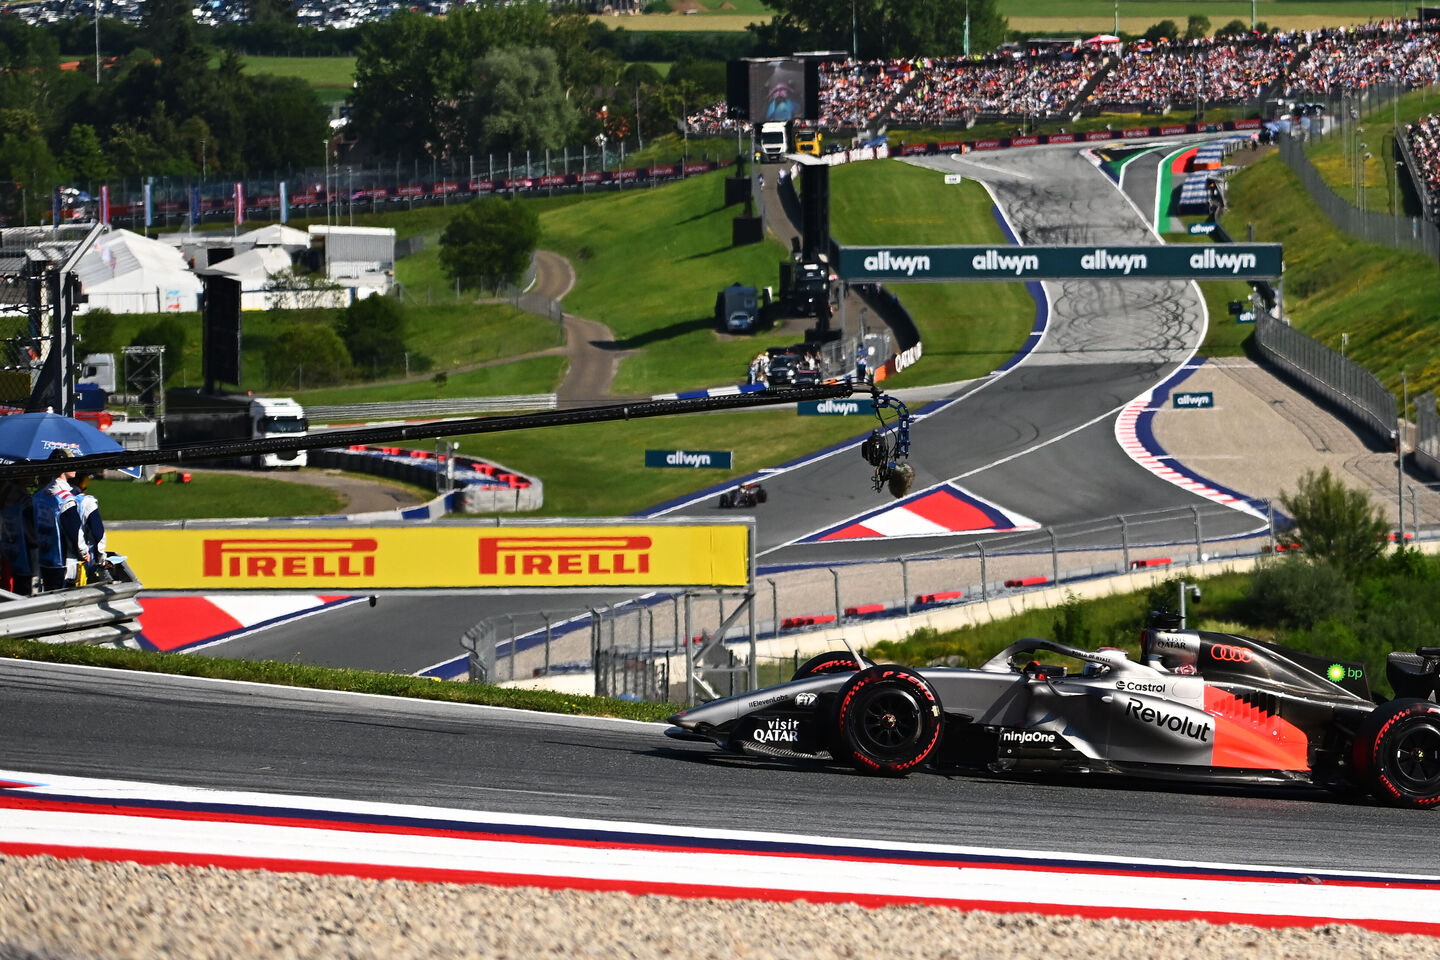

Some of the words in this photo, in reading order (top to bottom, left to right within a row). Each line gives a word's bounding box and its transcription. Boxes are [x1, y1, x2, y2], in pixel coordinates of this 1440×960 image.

[864, 251, 930, 276] allwyn
[972, 250, 1039, 275] allwyn
[1080, 249, 1147, 275] allwyn
[1190, 248, 1256, 274] allwyn
[817, 400, 858, 416] allwyn
[1177, 395, 1209, 407] allwyn
[666, 451, 711, 468] allwyn
[202, 538, 378, 577] PIRELLI
[478, 536, 652, 575] PIRELLI
[1157, 641, 1186, 649] QATAR
[1347, 667, 1363, 680] bp
[882, 670, 895, 678] P
[896, 671, 936, 702] ZERO
[1127, 682, 1165, 693] Castrol
[768, 718, 799, 730] visit
[1125, 698, 1211, 743] Revolut
[753, 729, 798, 743] QATAR
[1003, 731, 1056, 743] ninjaOne
